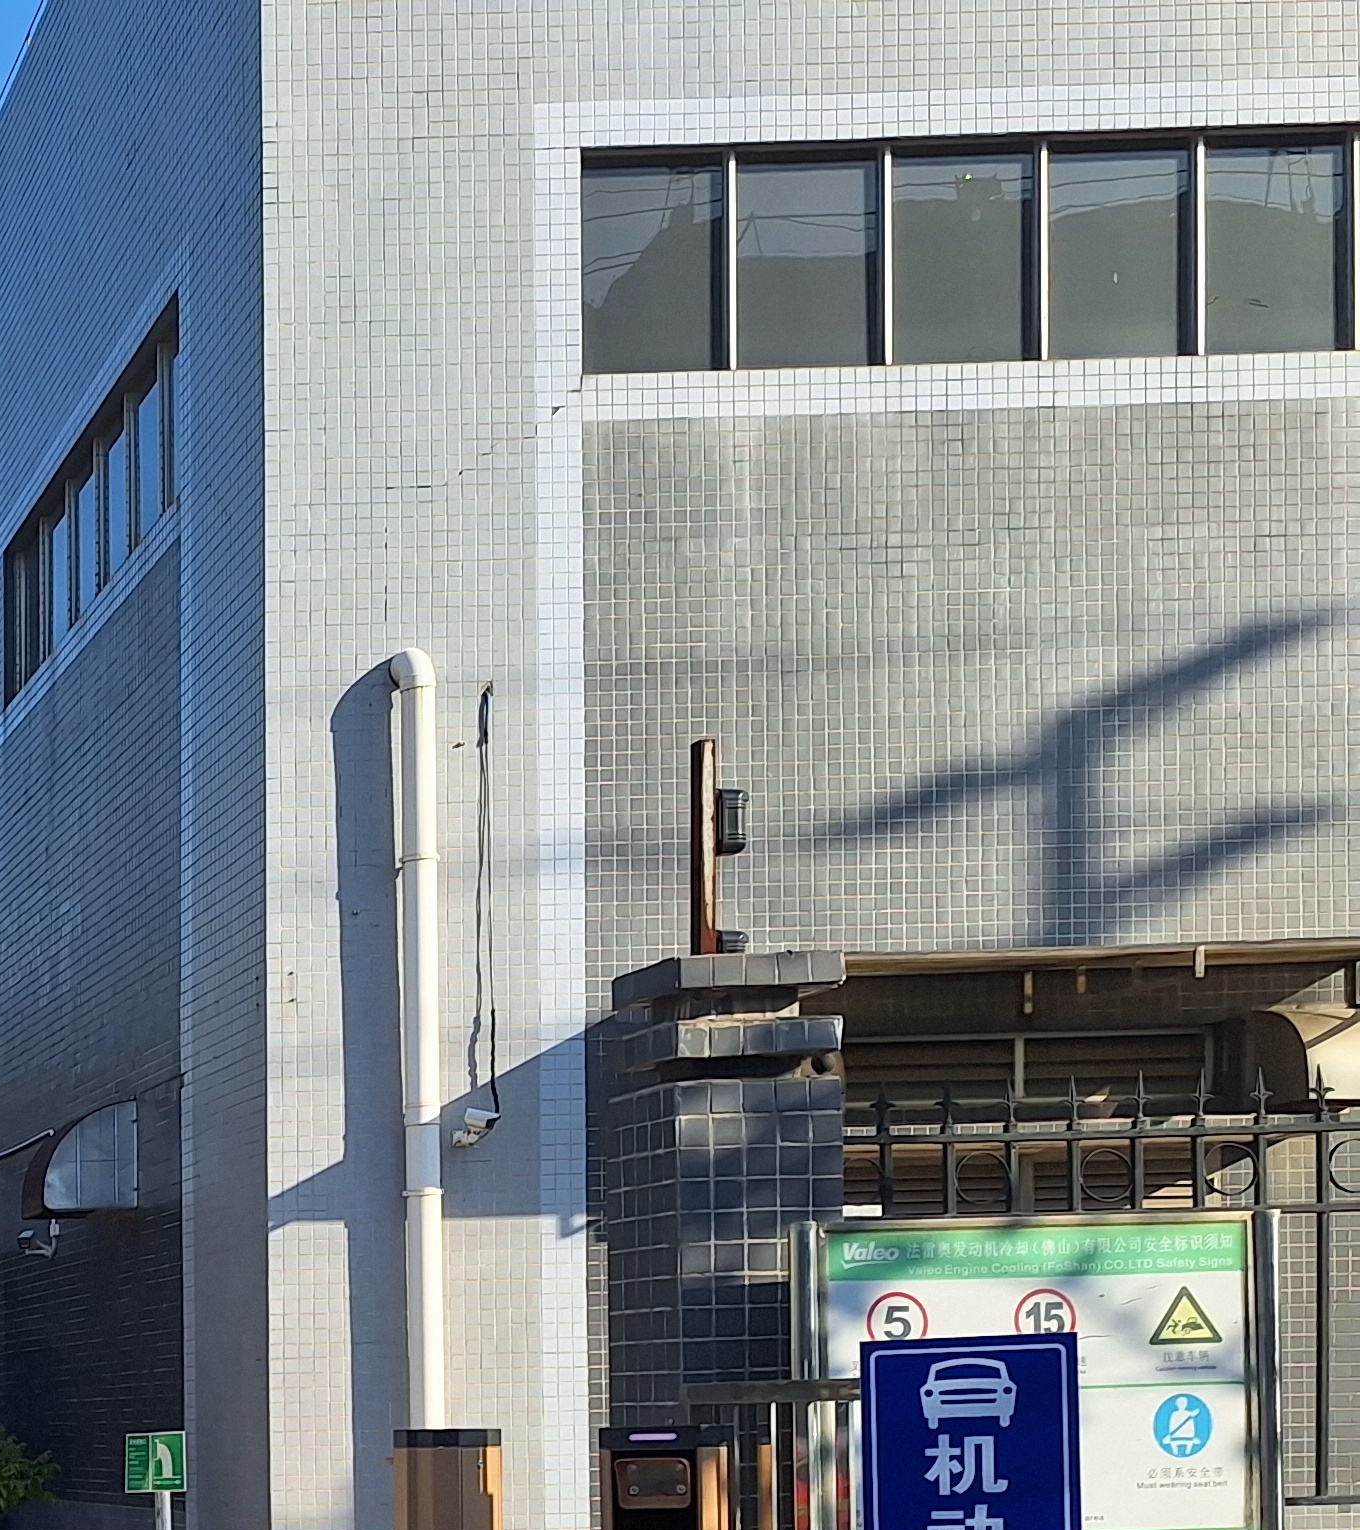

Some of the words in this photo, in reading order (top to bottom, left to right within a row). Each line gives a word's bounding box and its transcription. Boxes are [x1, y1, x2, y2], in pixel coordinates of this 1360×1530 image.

[841, 1240, 900, 1261] Valeo
[907, 1264, 942, 1275] Valeo
[944, 1263, 988, 1276] Engine
[991, 1261, 1040, 1275] Cooling
[1156, 1256, 1197, 1269] Safety
[1198, 1255, 1233, 1268] Signs
[883, 1305, 912, 1339] 5
[1025, 1301, 1066, 1333] 15
